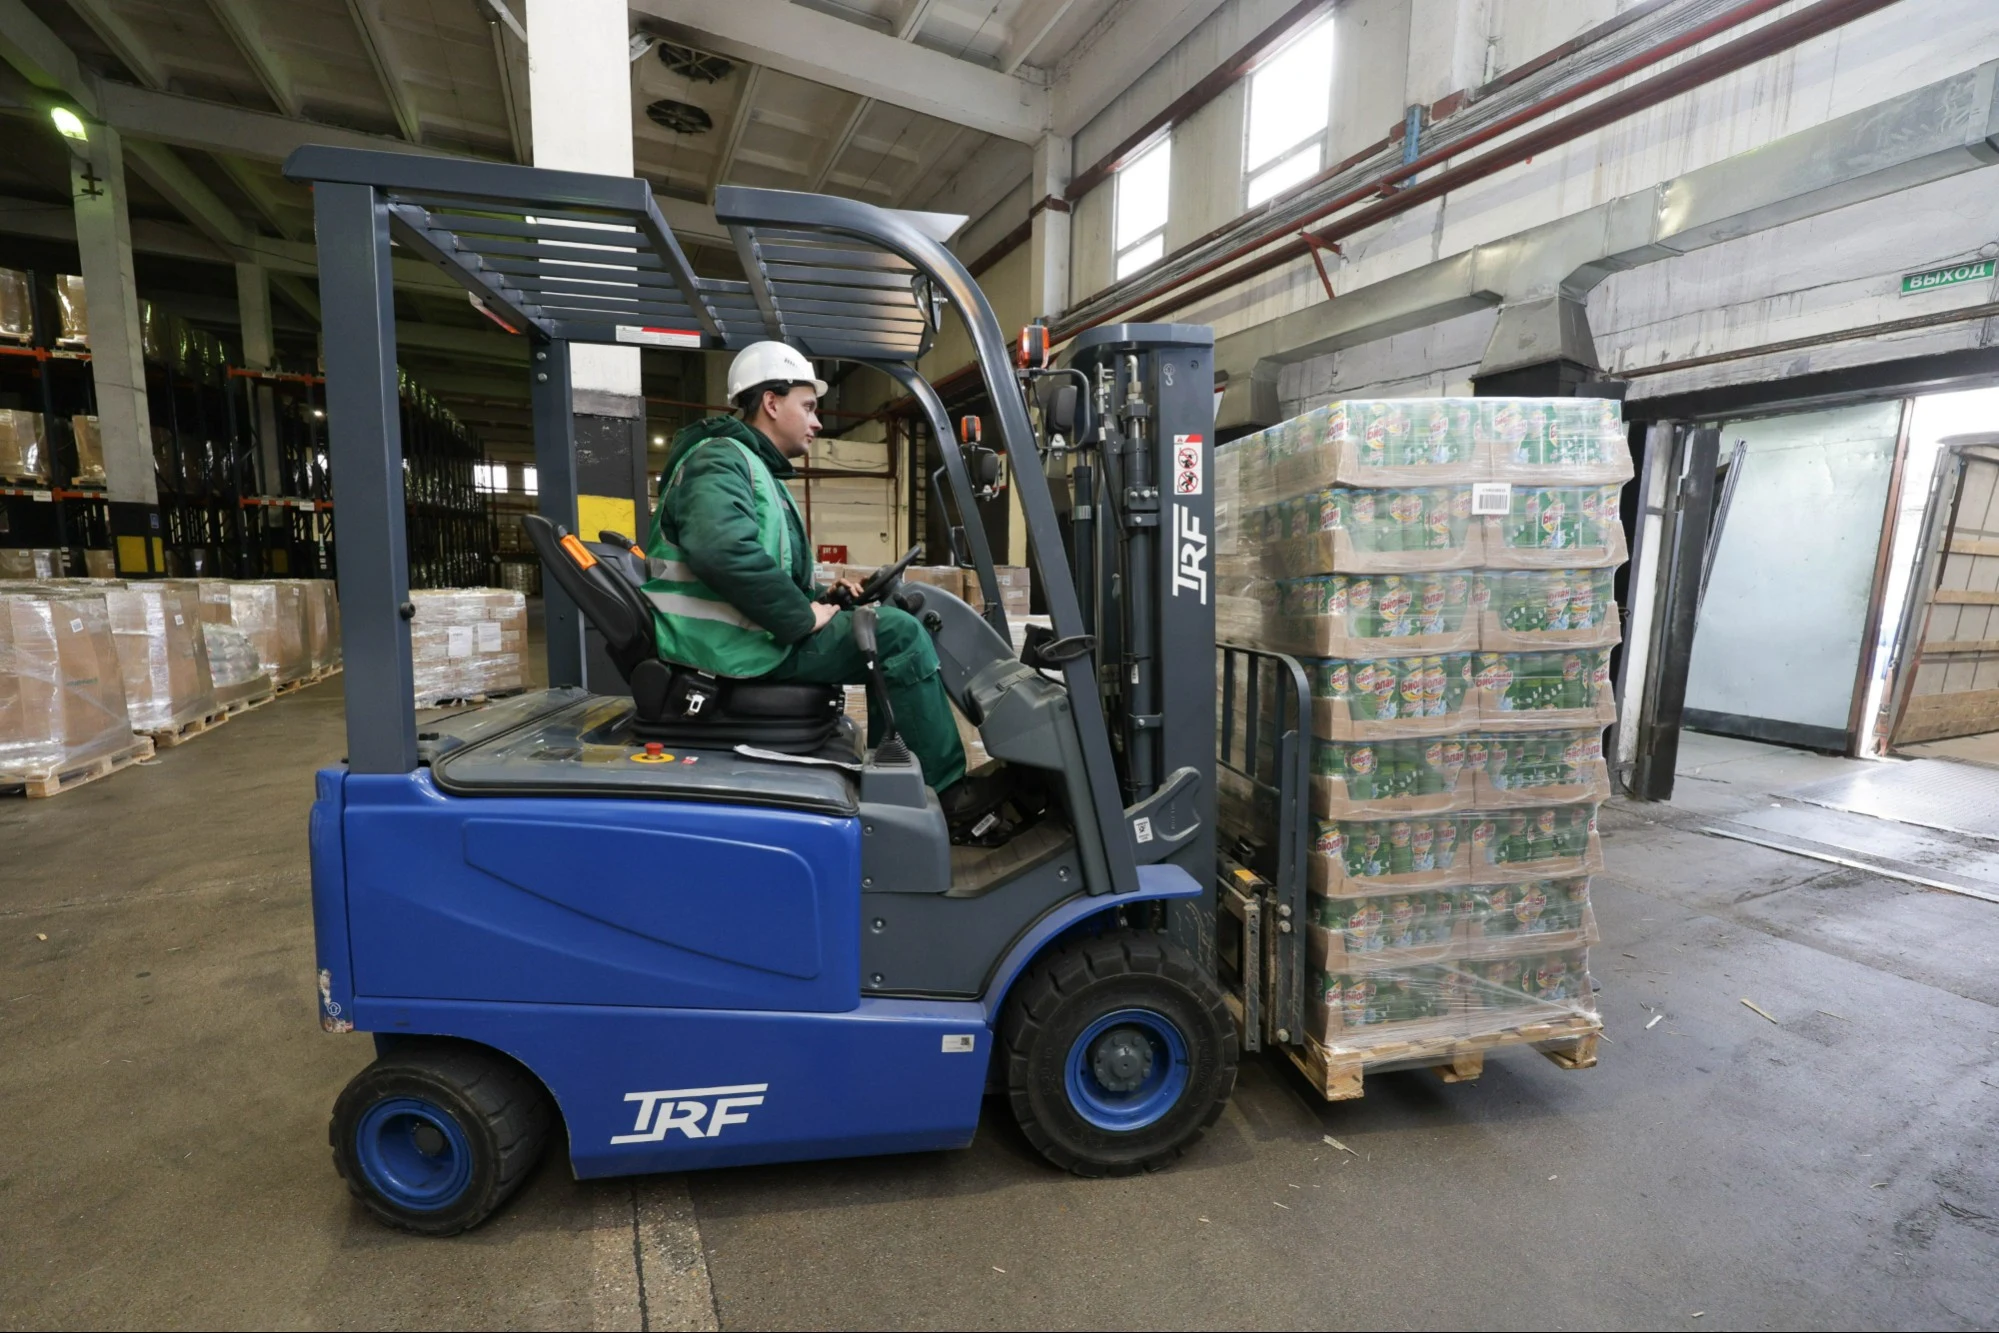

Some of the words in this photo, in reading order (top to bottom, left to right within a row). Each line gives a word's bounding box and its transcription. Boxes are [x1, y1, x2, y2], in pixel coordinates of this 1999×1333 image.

[1909, 263, 1986, 289] ВЫХОД
[1172, 503, 1208, 606] TRF
[610, 1083, 769, 1144] TRF
